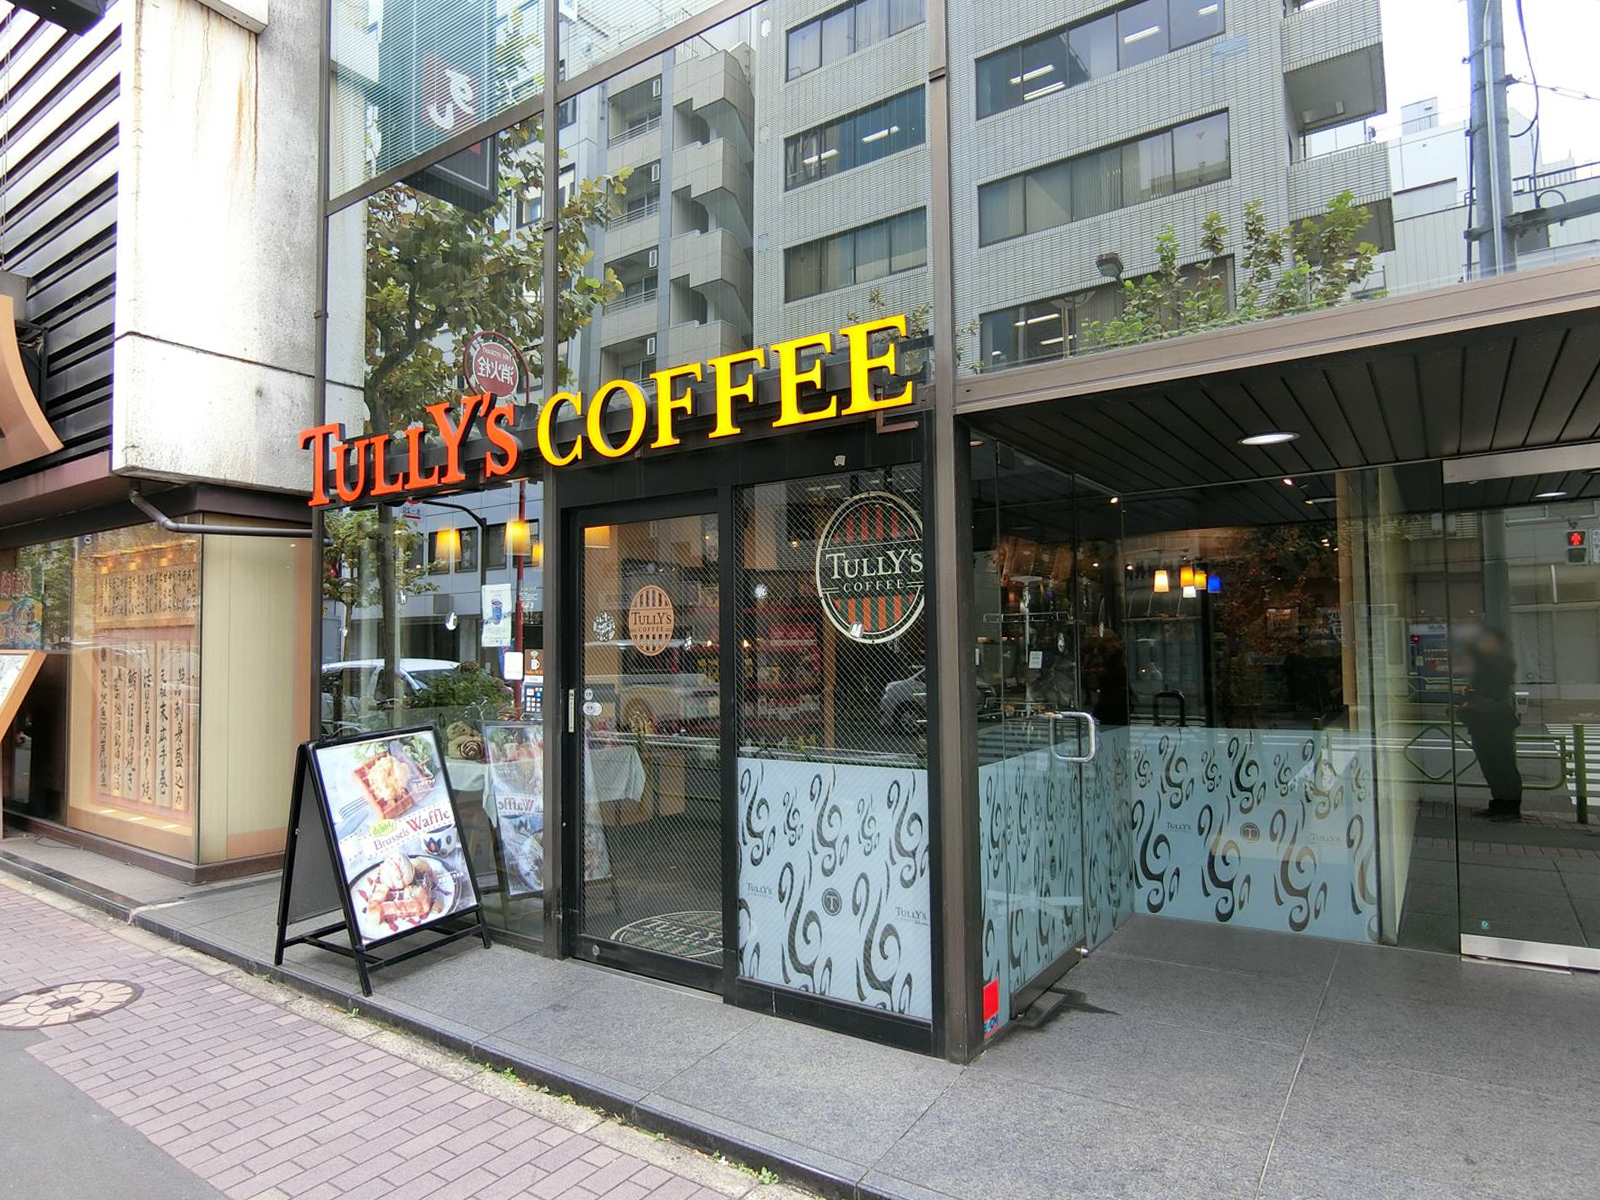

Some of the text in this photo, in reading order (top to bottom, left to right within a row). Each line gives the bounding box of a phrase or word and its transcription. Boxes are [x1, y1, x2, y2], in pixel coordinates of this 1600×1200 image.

[537, 314, 915, 467] COFFEE
[826, 549, 924, 579] TULLY'S
[843, 579, 905, 592] COFFEE
[631, 611, 672, 625] TULLY'S
[373, 828, 410, 850] Brussels
[406, 808, 450, 832] Waffle
